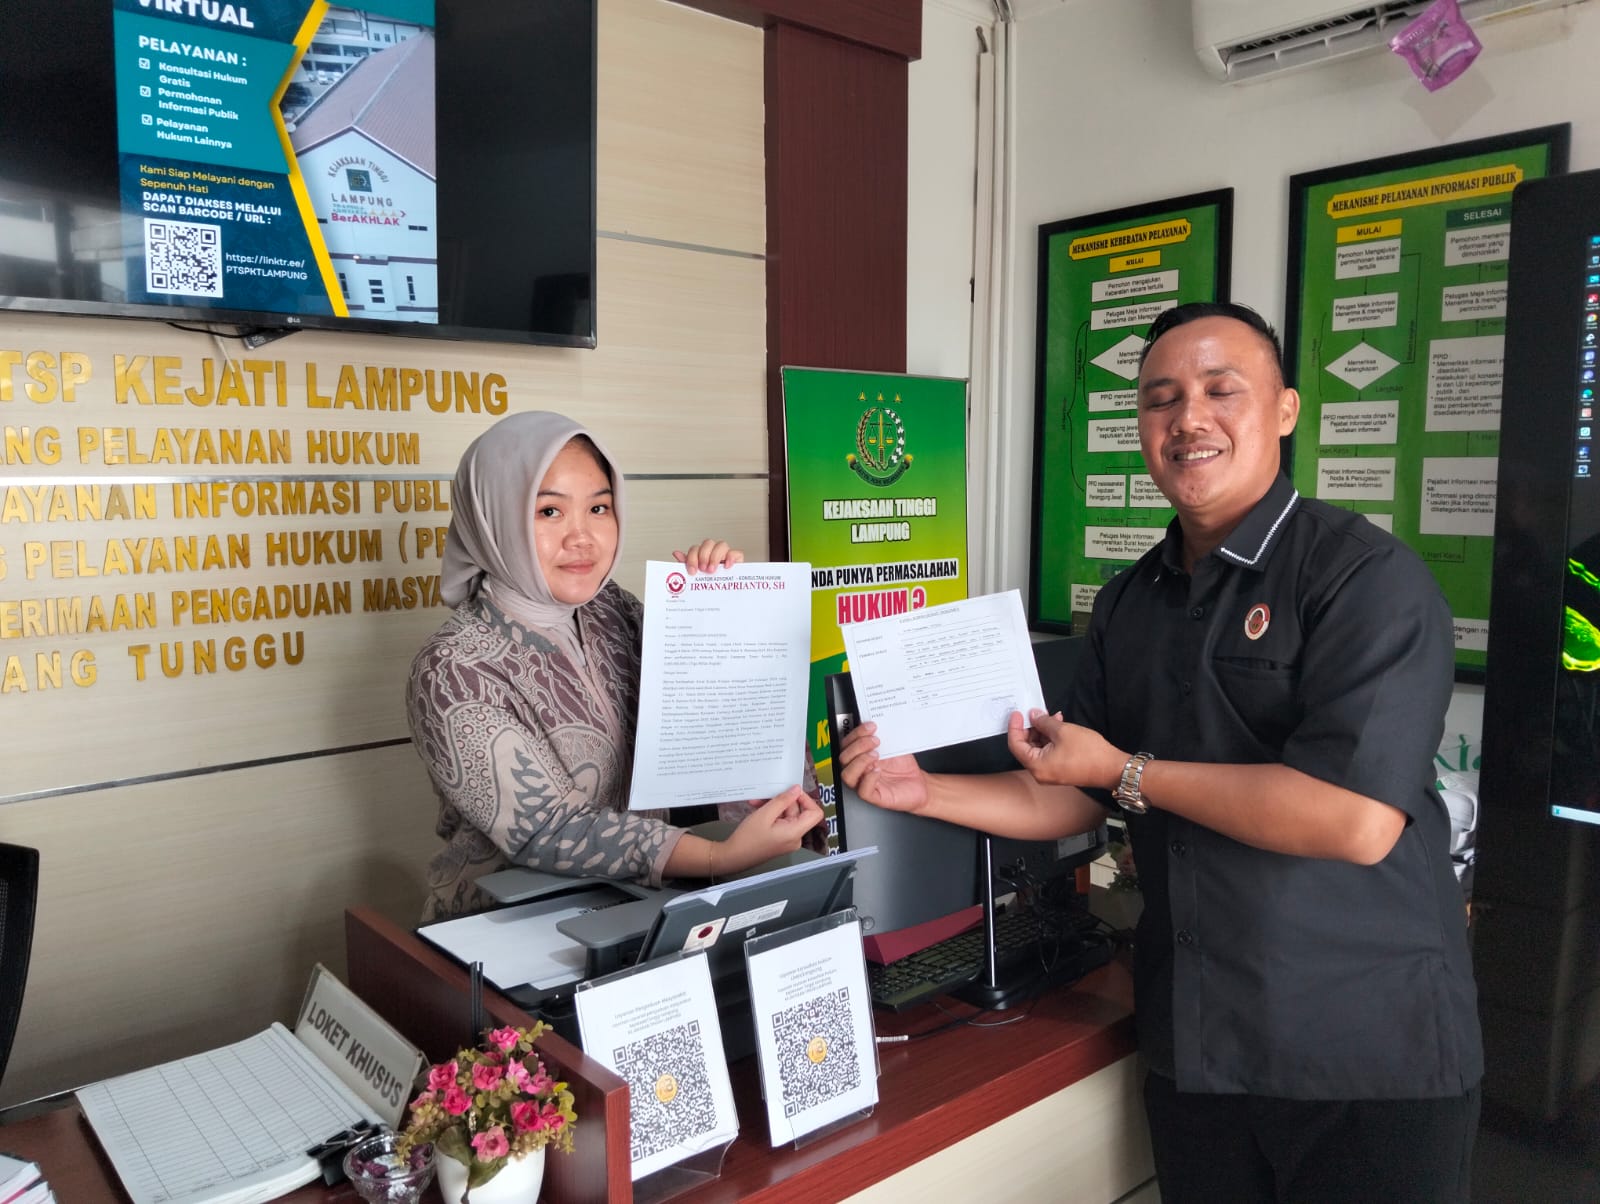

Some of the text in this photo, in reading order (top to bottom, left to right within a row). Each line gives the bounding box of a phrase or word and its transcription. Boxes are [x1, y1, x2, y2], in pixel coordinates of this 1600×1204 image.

[138, 35, 238, 66] PELAYANAN
[158, 62, 248, 85] Konsultasi Hukum
[159, 75, 191, 88] Gratis
[158, 88, 222, 105] Permohonan
[158, 101, 239, 121] Informasi Publik
[156, 118, 208, 133] Pelayanan
[156, 131, 233, 149] Hukum Lainnya
[139, 165, 275, 190] Kami Siap Melayani dengan
[328, 156, 390, 183] KEJAKSAAN TINGGI
[139, 178, 209, 194] Sepenuh Hati
[1331, 171, 1517, 213] MEKANISME PELAYANAN INFORMASI PUBLIK
[142, 191, 282, 216] DAPAT DIAKSES MELALUI
[331, 193, 393, 208] LAMPUNG
[142, 203, 176, 214] SCAN
[178, 207, 234, 222] BARCODE
[244, 214, 265, 225] URL
[331, 212, 400, 226] BerAKHLAK
[1463, 208, 1502, 221] SELESAI
[1071, 224, 1188, 254] MEKANISME KEBERATAN PELAYANAN
[1356, 226, 1382, 237] MULAI
[1125, 257, 1144, 266] MULAI
[226, 266, 308, 281] PTSPKTLAMPUNG
[114, 353, 287, 407] KEJATI
[305, 361, 509, 416] LAMPUNG
[77, 427, 293, 466] PELAYANAN
[306, 429, 421, 465] HUKUM
[2, 483, 157, 524] AYANAN
[173, 480, 361, 519] INFORMASI
[823, 498, 937, 520] KEJAKSAAN TINGGI
[851, 522, 911, 544] LAMPUNG
[24, 533, 251, 580] PELAYANAN
[266, 529, 382, 567] HUKUM
[836, 567, 874, 586] PUNYA
[876, 560, 957, 582] PERMASALAHAN
[690, 581, 785, 591] IRWANAPRIANTO, SH
[0, 592, 157, 639] ERIMAAN
[172, 579, 352, 627] PENGADUAN
[838, 589, 908, 625] HUKUM
[1, 631, 305, 693] ANG TUNGGU
[307, 1001, 403, 1108] LOKET KHUSUS
